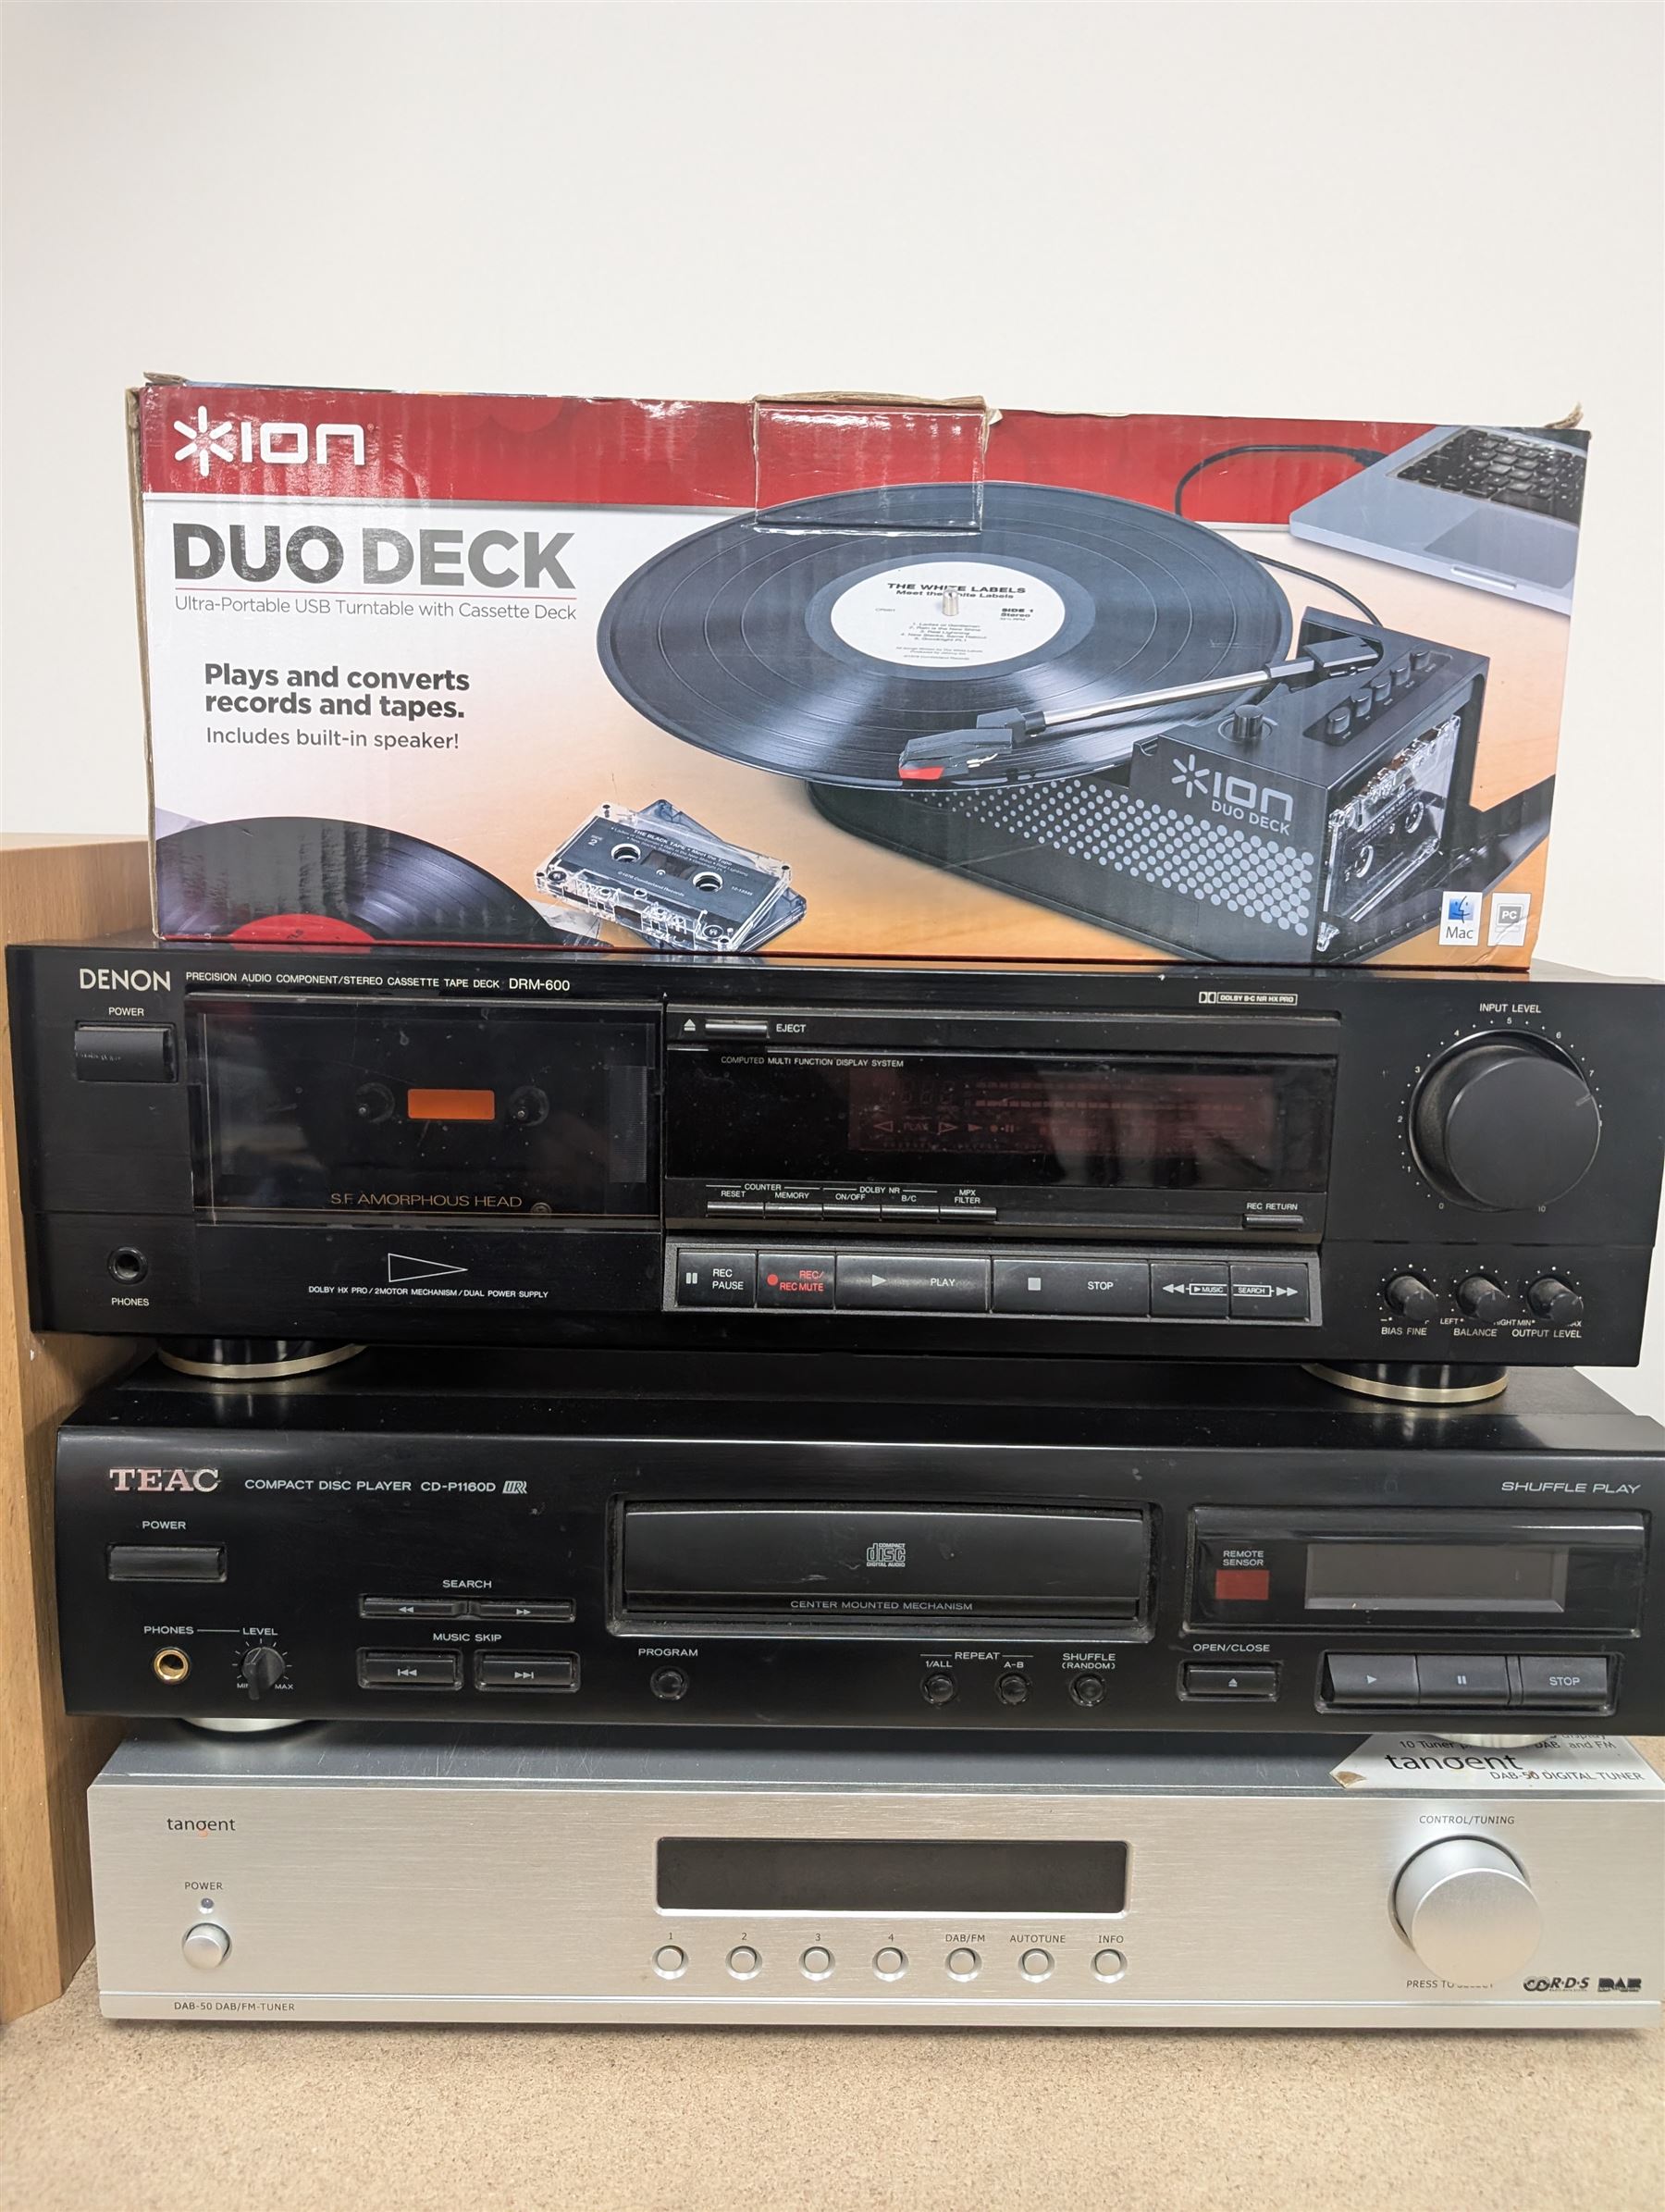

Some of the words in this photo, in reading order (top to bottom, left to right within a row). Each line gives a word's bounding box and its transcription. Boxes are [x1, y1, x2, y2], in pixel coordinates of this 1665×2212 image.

[173, 523, 344, 585] DUO
[362, 527, 576, 589] DECK
[886, 582, 916, 590] THE
[970, 586, 1026, 594] LABELS
[174, 595, 290, 613] Ultra-Portable
[294, 597, 331, 614] USB
[335, 599, 414, 617] Turntable
[417, 600, 454, 618] with
[458, 602, 530, 620] Cassette
[534, 603, 577, 621] Deck
[204, 662, 278, 689] Plays
[287, 664, 339, 688] and
[346, 669, 471, 691] converts
[204, 691, 312, 715] records
[319, 692, 372, 717] and
[378, 696, 465, 722] tapes.
[206, 726, 290, 747] Includes
[296, 728, 368, 748] built-in
[374, 730, 460, 750] speaker!
[1211, 798, 1248, 821] DUO
[1248, 811, 1291, 836] DECK
[1501, 908, 1518, 921] PC
[1445, 925, 1474, 941] Mac
[79, 968, 172, 992] DENON
[186, 971, 238, 983] PRECISION
[241, 972, 272, 983] AUDIO
[276, 973, 384, 986] COMPONENT/STEREO
[387, 976, 440, 988] CASSETTE
[443, 978, 470, 989] TAPE
[473, 979, 500, 989] DECK
[508, 978, 571, 992] DRM-600
[108, 1006, 144, 1017] POWER
[1479, 1003, 1509, 1013] INPUT
[1511, 1004, 1542, 1014] LEVEL
[1507, 1017, 1512, 1025] 5
[776, 1023, 807, 1033] EJECT
[1556, 1031, 1562, 1039] 6
[721, 1056, 765, 1065] COMPUTED
[767, 1057, 792, 1066] MULTI
[794, 1057, 833, 1066] FUNCTION
[835, 1058, 869, 1067] DISPLAY
[871, 1059, 904, 1068] SYSTEM
[1397, 1115, 1403, 1123] 2
[744, 1183, 783, 1192] COUNTER
[859, 1186, 886, 1194] DOLBY
[888, 1186, 901, 1194] NR
[721, 1190, 746, 1198] RESET
[774, 1191, 810, 1200] MEMORY
[834, 1193, 866, 1201] ON/OFF
[958, 1189, 977, 1197] MPX
[358, 1193, 470, 1207] AMORPHOUS
[475, 1195, 523, 1208] HEAD
[901, 1194, 917, 1203] B/C
[954, 1196, 980, 1205] FILTER
[1246, 1203, 1264, 1211] REC
[1265, 1203, 1299, 1211] RETURN
[712, 1268, 733, 1279] REC
[799, 1269, 825, 1279] REC/
[711, 1280, 745, 1291] PAUSE
[779, 1281, 798, 1291] REC
[798, 1282, 825, 1292] MUTE
[930, 1277, 956, 1287] PLAY
[1087, 1280, 1114, 1291] STOP
[338, 1286, 349, 1294] HX
[487, 1290, 516, 1298] POWER
[518, 1291, 549, 1299] SUPPLY
[1202, 1285, 1224, 1294] MUSIC
[1237, 1286, 1265, 1294] SEARCH
[111, 1297, 150, 1306] PHONES
[1493, 1318, 1516, 1327] IGHT
[1381, 1326, 1403, 1336] BIAS
[1406, 1327, 1427, 1336] FINE
[1453, 1328, 1498, 1337] BALANCE
[1511, 1328, 1549, 1338] OUTPUT
[1553, 1329, 1582, 1339] LEVEL
[108, 1467, 221, 1493] TEAC
[244, 1479, 314, 1491] COMPACT
[318, 1480, 352, 1492] DISC
[356, 1480, 412, 1492] PLAYER
[420, 1481, 497, 1493] CD-P1160D
[1501, 1480, 1587, 1494] SHUFFLE
[1592, 1482, 1642, 1496] PLAY
[142, 1520, 187, 1529] POWER
[1222, 1550, 1264, 1559] REMOTE
[1222, 1558, 1264, 1567] SENSOR
[442, 1579, 492, 1589] SEARCH
[790, 1600, 838, 1611] CENTER
[841, 1600, 900, 1612] MOUNTED
[903, 1601, 973, 1612] MECHANISM
[143, 1625, 194, 1636] PHONES
[242, 1627, 278, 1637] LEVEL
[432, 1632, 472, 1643] MUSIC
[475, 1633, 502, 1643] SKIP
[637, 1648, 698, 1658] PROGRAM
[1192, 1643, 1271, 1653] OPEN/CLOSE
[954, 1651, 1001, 1662] REPEAT
[1062, 1652, 1116, 1662] SHUFFLE
[925, 1660, 953, 1669] 1/ALL
[1003, 1661, 1025, 1670] A-B
[1062, 1662, 1116, 1671] (RANDOM)
[1548, 1675, 1581, 1687] STOP
[1399, 1740, 1415, 1749] 10
[1418, 1740, 1454, 1749] Tuner
[1568, 1740, 1593, 1749] and
[1595, 1740, 1617, 1749] FM
[1490, 1771, 1538, 1781] DAB-50
[1542, 1772, 1597, 1780] DIGITAL
[1597, 1773, 1646, 1781] TUNER
[1419, 1814, 1515, 1825] CONTROL/TUNING
[184, 1881, 223, 1891] POWER
[668, 1932, 674, 1940] 1
[741, 1932, 747, 1941] 2
[815, 1933, 821, 1942] 3
[887, 1933, 894, 1942] 4
[944, 1934, 987, 1944] DAB/FM
[1009, 1934, 1067, 1944] AUTOTUNE
[1097, 1934, 1125, 1944] INFO
[1406, 1980, 1438, 1988] PRESS
[174, 2001, 213, 2010] DAB-50
[216, 2002, 295, 2012] DAB/FM-TUNER
